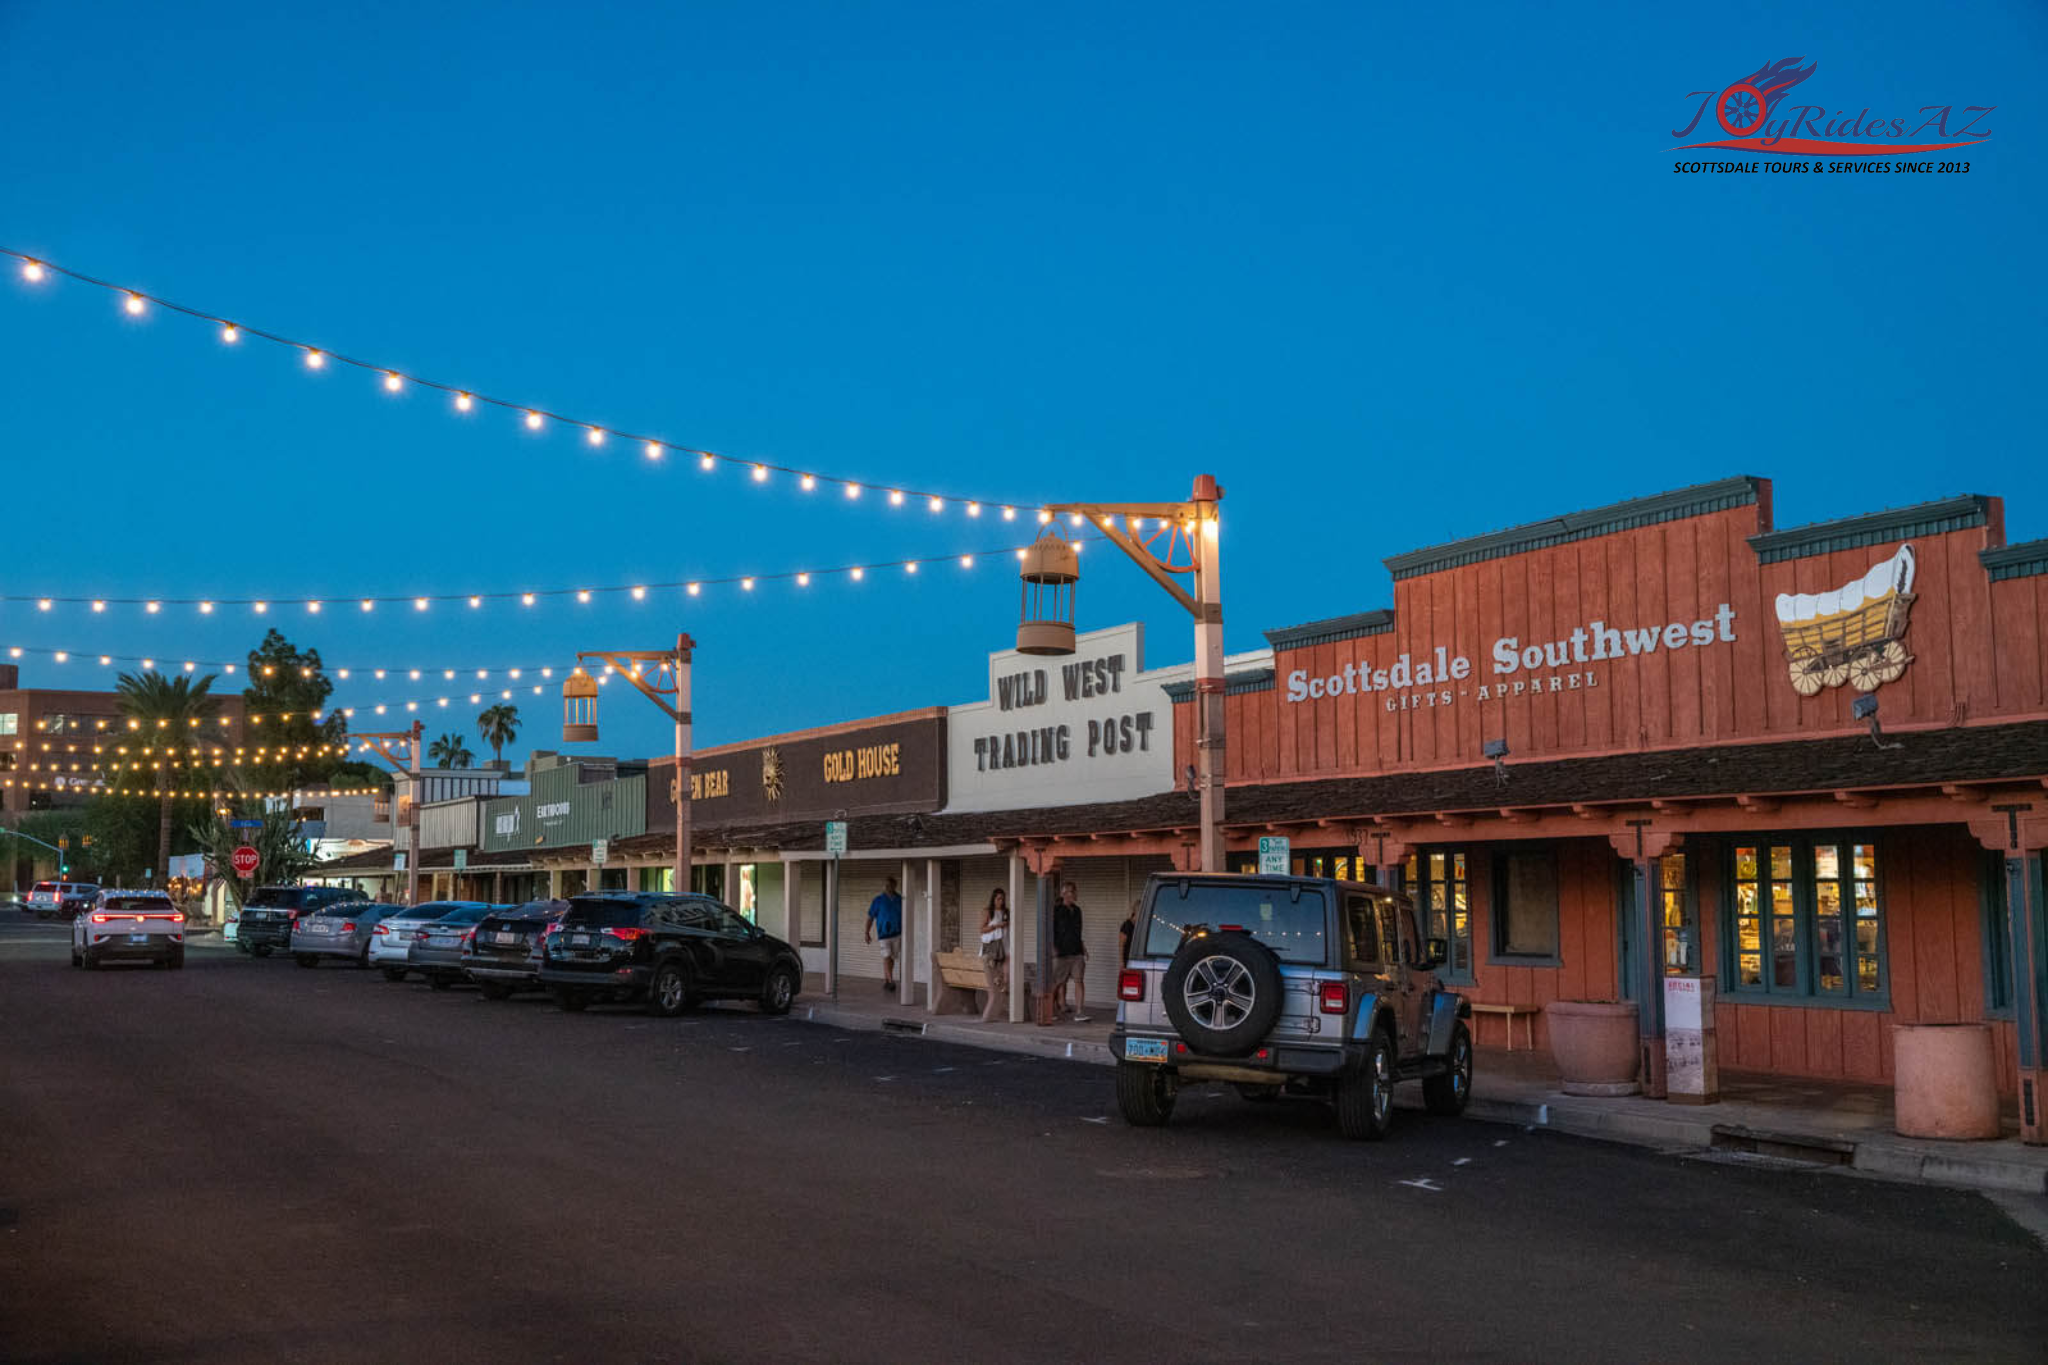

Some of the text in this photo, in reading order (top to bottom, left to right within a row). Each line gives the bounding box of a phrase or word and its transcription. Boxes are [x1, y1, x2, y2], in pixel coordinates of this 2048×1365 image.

[1287, 603, 1738, 703] Scottsdale Southwest
[998, 654, 1126, 712] WILD WEST
[1386, 689, 1454, 713] GIFTS
[1478, 671, 1600, 700] APPAREL
[974, 712, 1153, 772] TRADING POST
[824, 743, 900, 783] GOLD HOUSE
[704, 769, 729, 799] BEAR
[234, 854, 257, 865] STOP
[1261, 840, 1268, 852] 3
[1265, 855, 1282, 863] ANY
[1265, 863, 1285, 873] TIME
